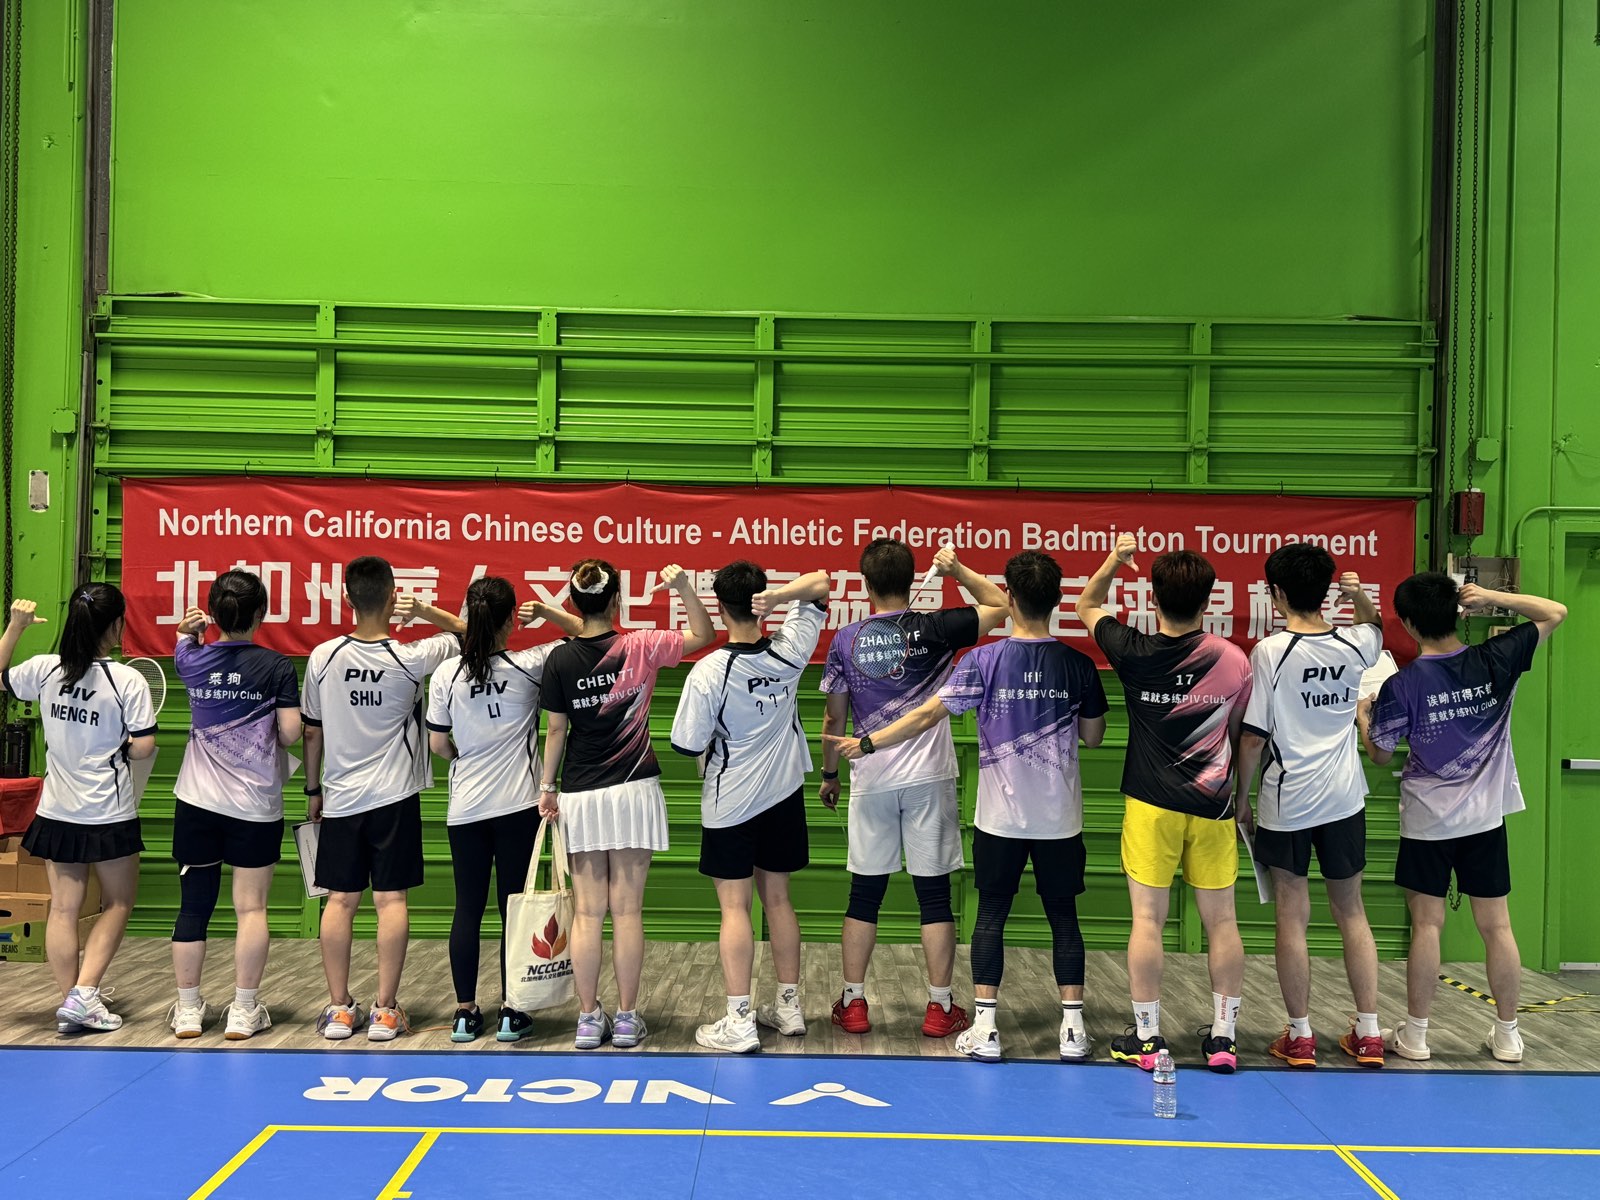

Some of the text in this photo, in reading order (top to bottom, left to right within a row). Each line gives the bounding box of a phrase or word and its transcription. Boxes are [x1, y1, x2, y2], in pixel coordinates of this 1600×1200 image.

[158, 508, 293, 537] Northern
[303, 509, 451, 541] California
[461, 513, 583, 544] Chinese
[593, 515, 702, 545] Culture
[728, 517, 844, 547] Athletic
[854, 518, 1011, 549] Federation
[859, 633, 902, 648] ZHANG
[913, 630, 921, 642] F
[908, 646, 928, 657] Club
[345, 668, 385, 683] PIV
[576, 667, 634, 690] CHEN 77
[1175, 673, 1194, 686] 17
[1302, 665, 1346, 683] PIV
[58, 684, 97, 702] PIV
[240, 689, 263, 701] Club
[470, 680, 509, 699] PIV
[626, 682, 647, 697] Club
[1048, 688, 1069, 699] Club
[1301, 687, 1350, 709] Yuan J
[1201, 694, 1227, 704] Club
[1480, 697, 1498, 711] Club
[50, 703, 100, 727] MENG R
[487, 702, 502, 719] LI
[1, 944, 19, 954] BEANS
[303, 1076, 736, 1106] VICTOR
